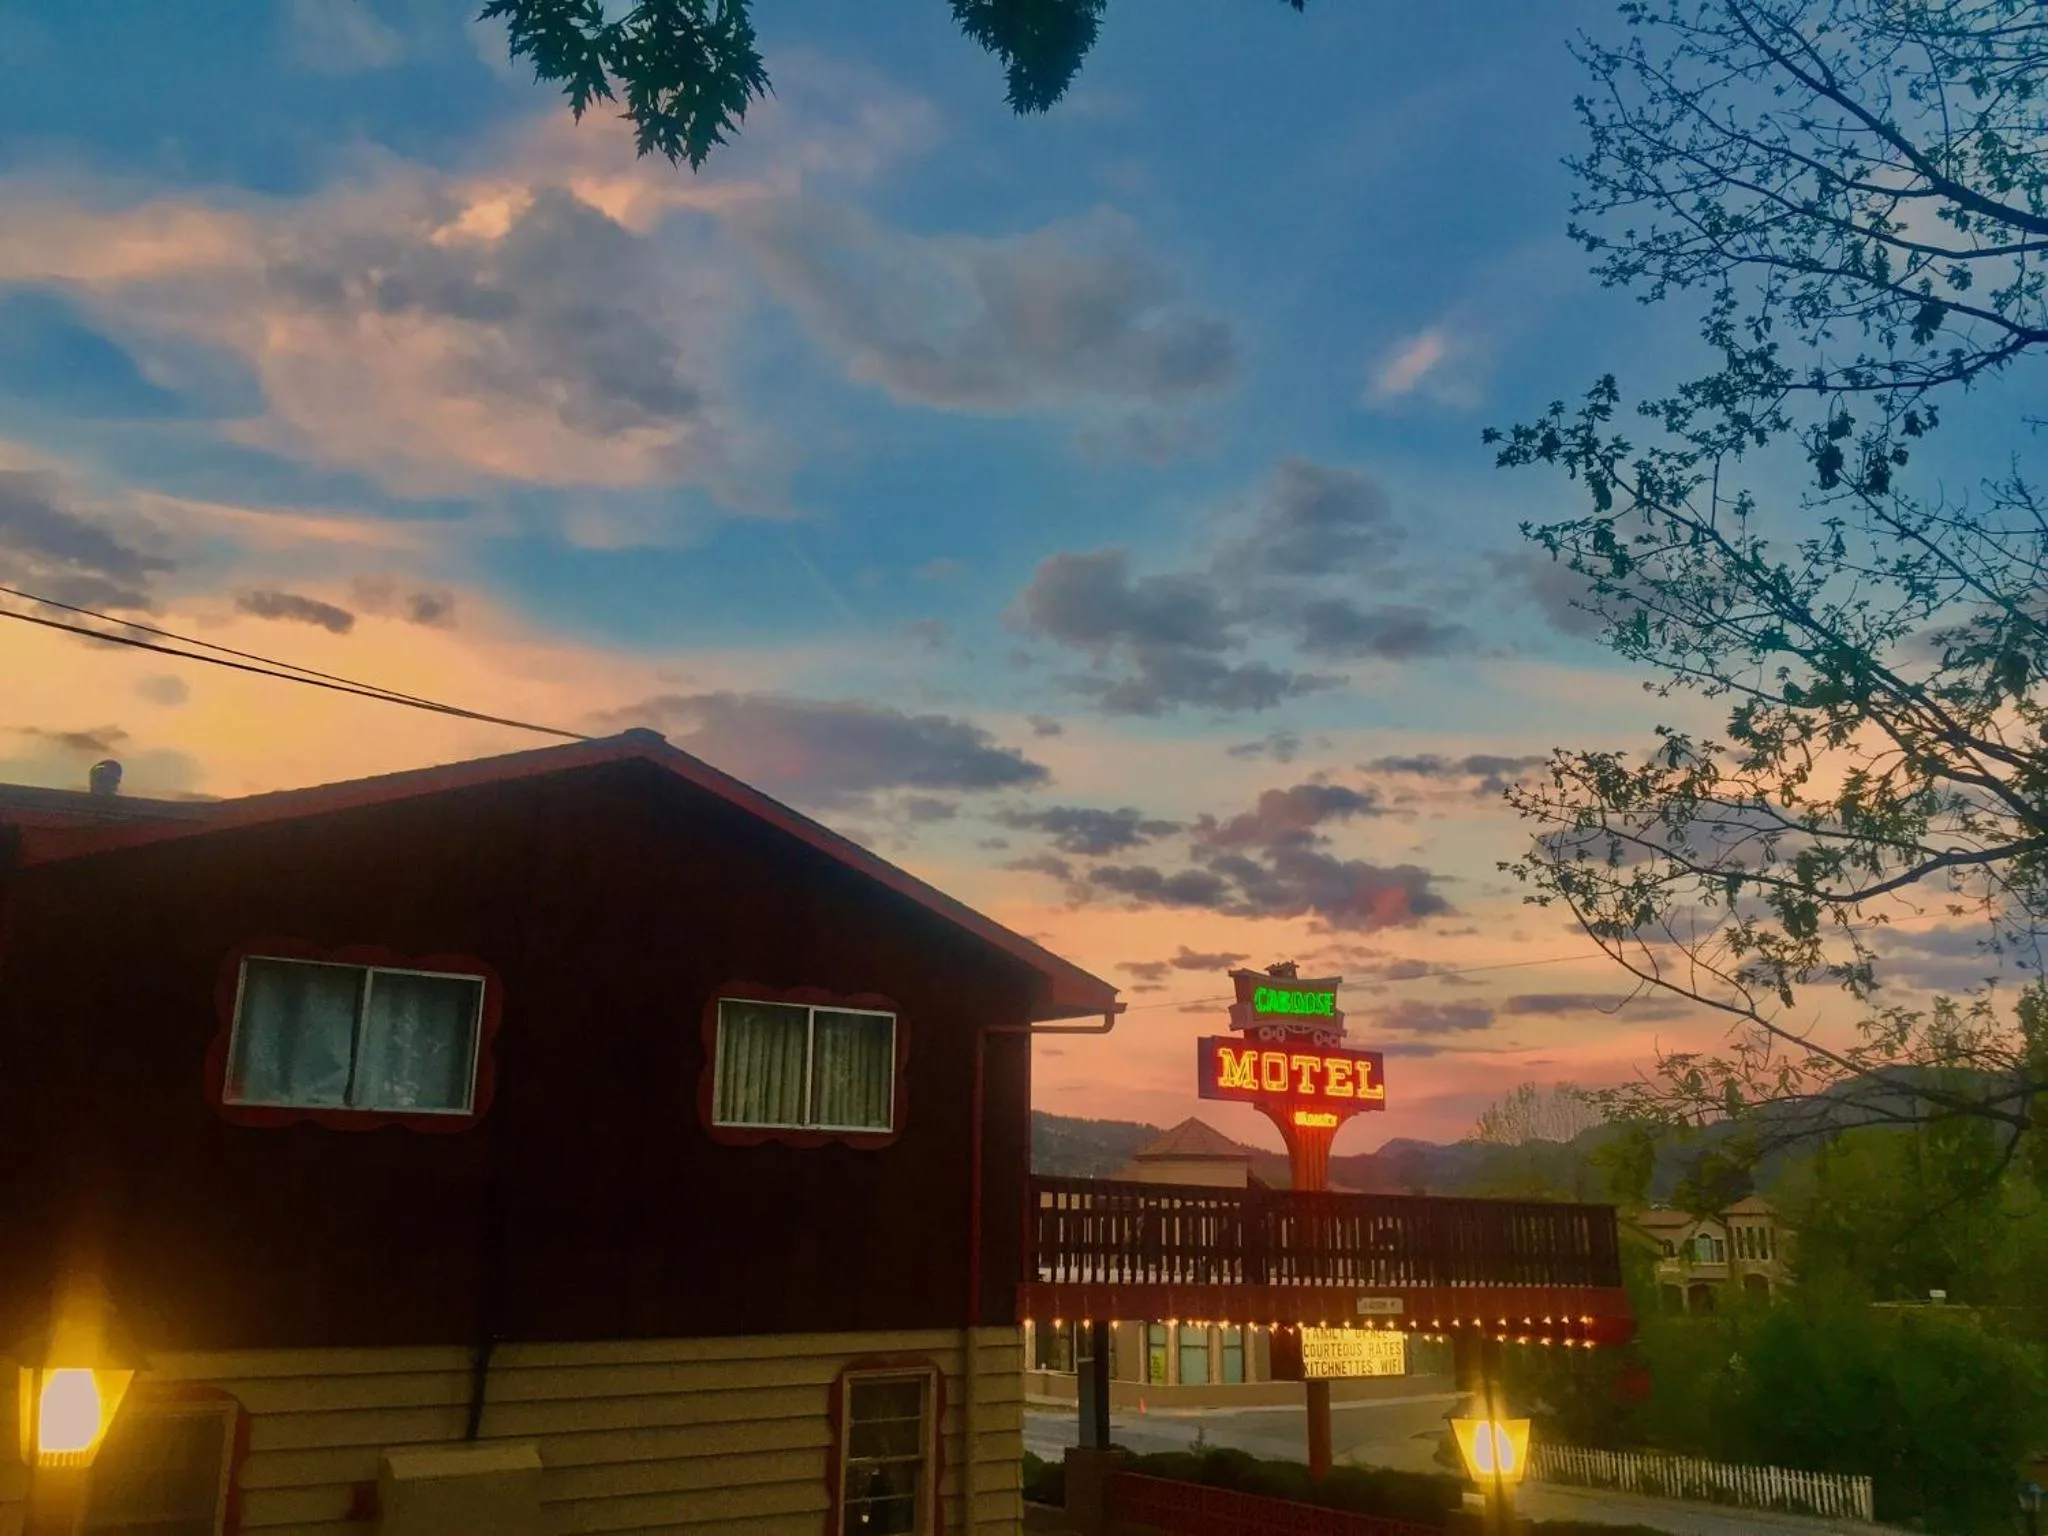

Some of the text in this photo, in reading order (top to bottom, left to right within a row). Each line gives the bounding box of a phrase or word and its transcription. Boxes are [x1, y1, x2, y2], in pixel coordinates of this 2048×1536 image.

[1254, 986, 1335, 1017] CABOOSE
[1217, 1047, 1384, 1100] MOTEL
[1303, 1342, 1402, 1358] COURTEOUS RATES
